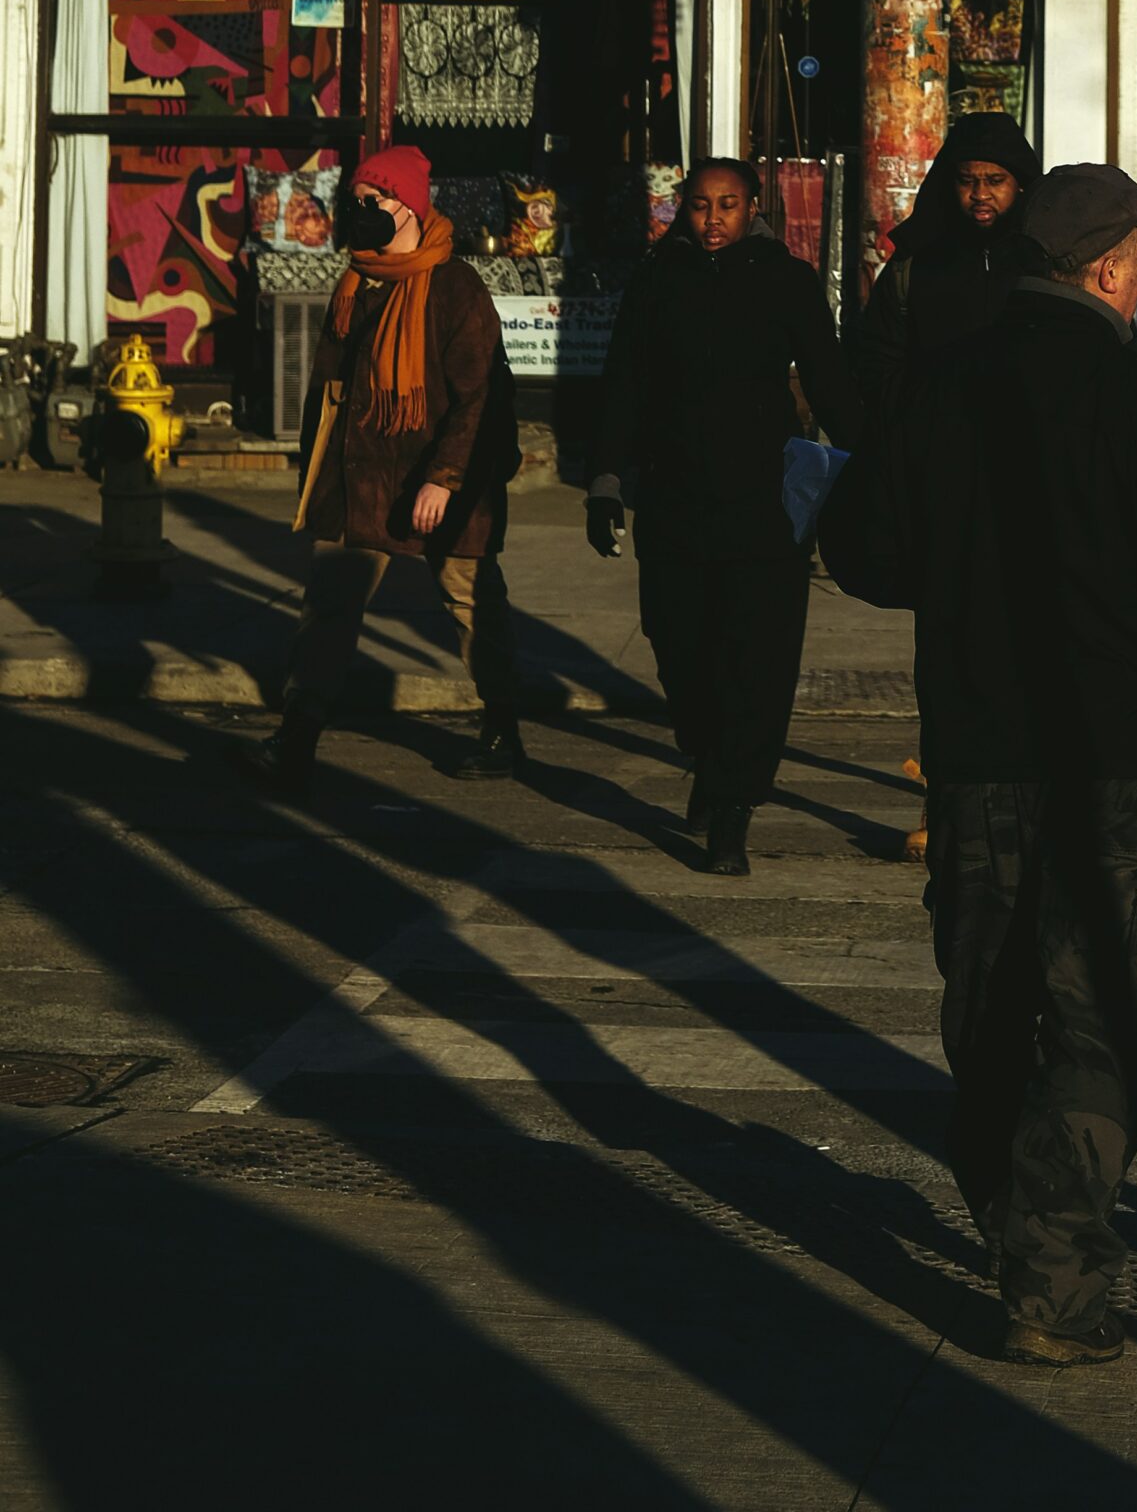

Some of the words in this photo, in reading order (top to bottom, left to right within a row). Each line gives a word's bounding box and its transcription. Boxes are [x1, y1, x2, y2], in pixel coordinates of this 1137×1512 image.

[501, 317, 568, 330] ndo-East
[504, 338, 537, 349] ailers
[508, 354, 537, 365] entic
